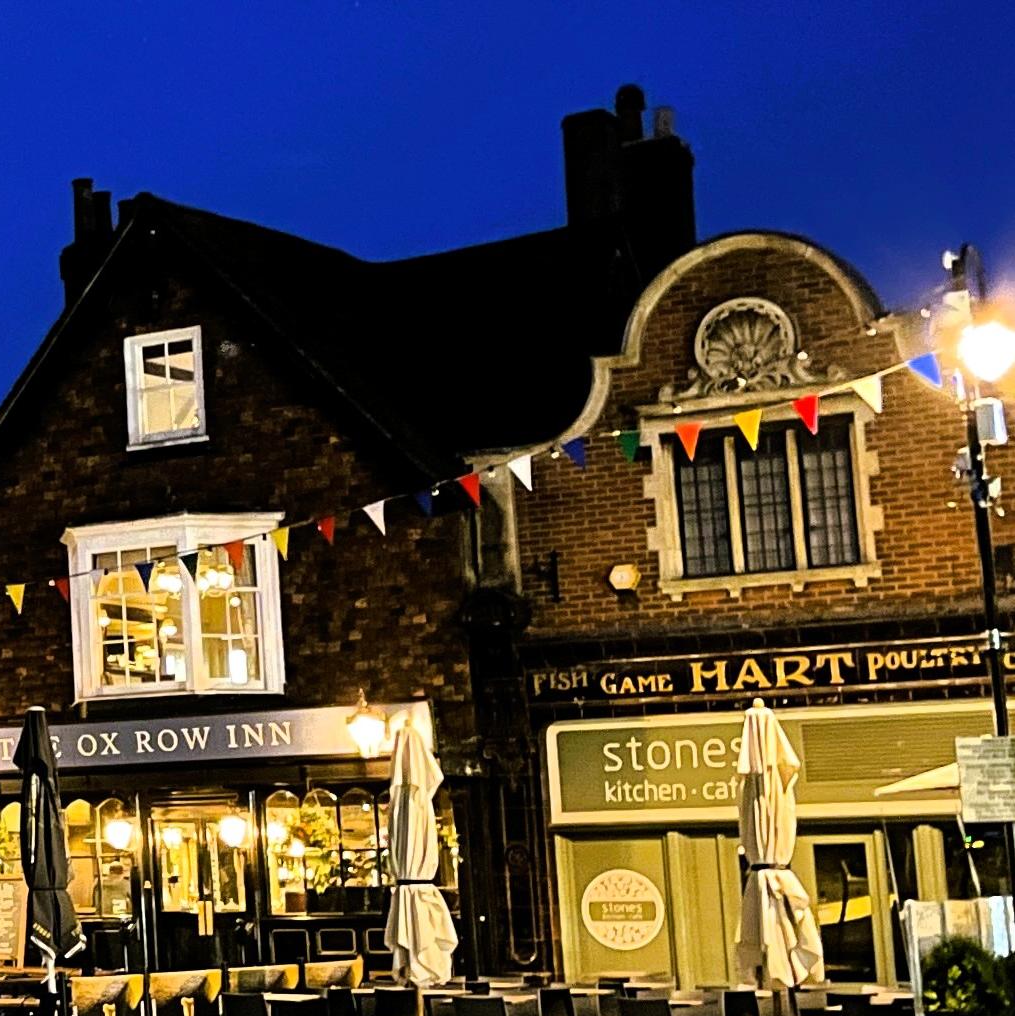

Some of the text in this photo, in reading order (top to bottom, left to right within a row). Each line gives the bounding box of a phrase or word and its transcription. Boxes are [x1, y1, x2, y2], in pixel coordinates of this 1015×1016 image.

[534, 671, 588, 697] FISH
[600, 672, 673, 695] GAME
[690, 652, 855, 693] HART
[866, 645, 982, 681] POULTRY
[77, 732, 121, 757] OX
[134, 726, 211, 754] ROW
[226, 721, 292, 749] INN
[604, 776, 738, 803] kitchen caf
